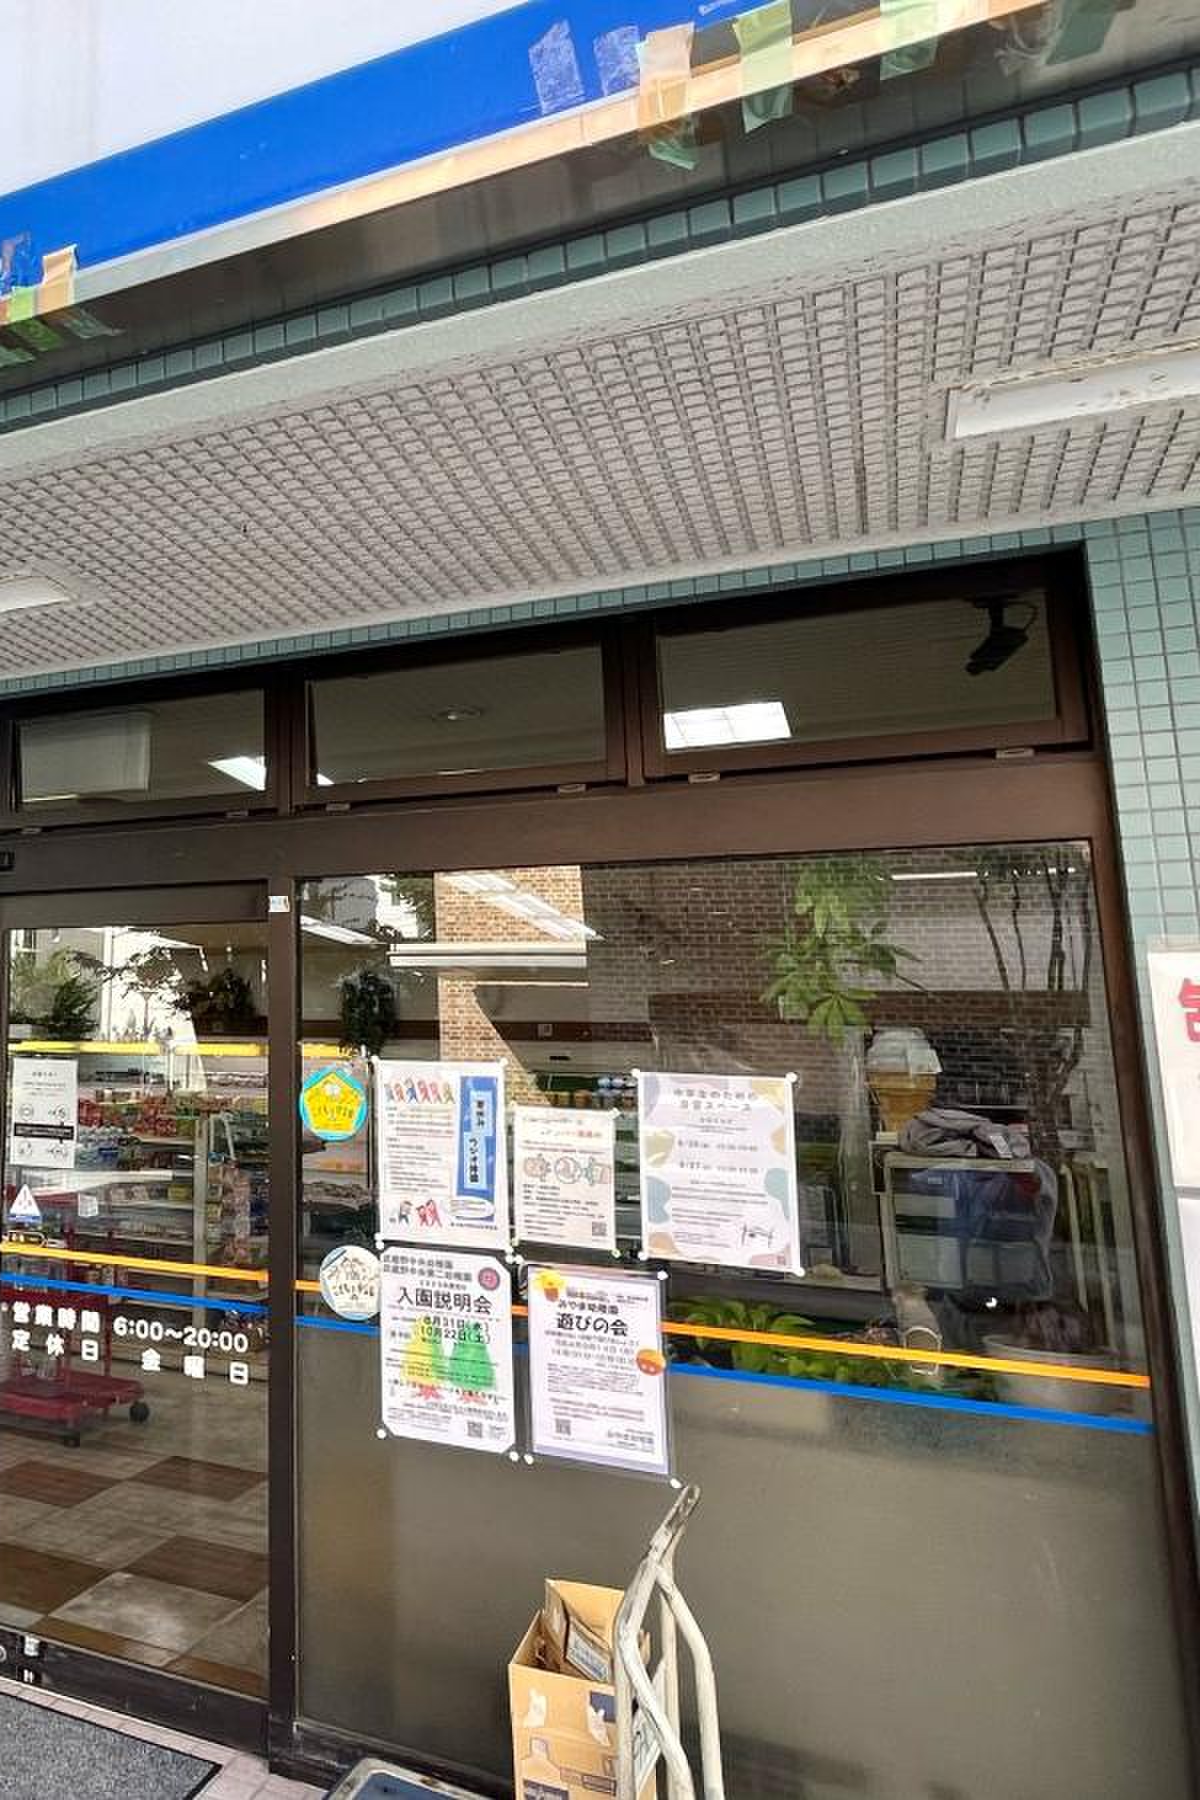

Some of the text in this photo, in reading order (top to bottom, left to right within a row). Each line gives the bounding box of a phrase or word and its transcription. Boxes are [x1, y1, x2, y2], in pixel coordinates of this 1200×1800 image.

[398, 1287, 493, 1315] 入園説明会
[12, 1301, 100, 1334] 営業時間
[556, 1312, 629, 1338] 遊びの会
[12, 1329, 249, 1385] 定休日 金曜日
